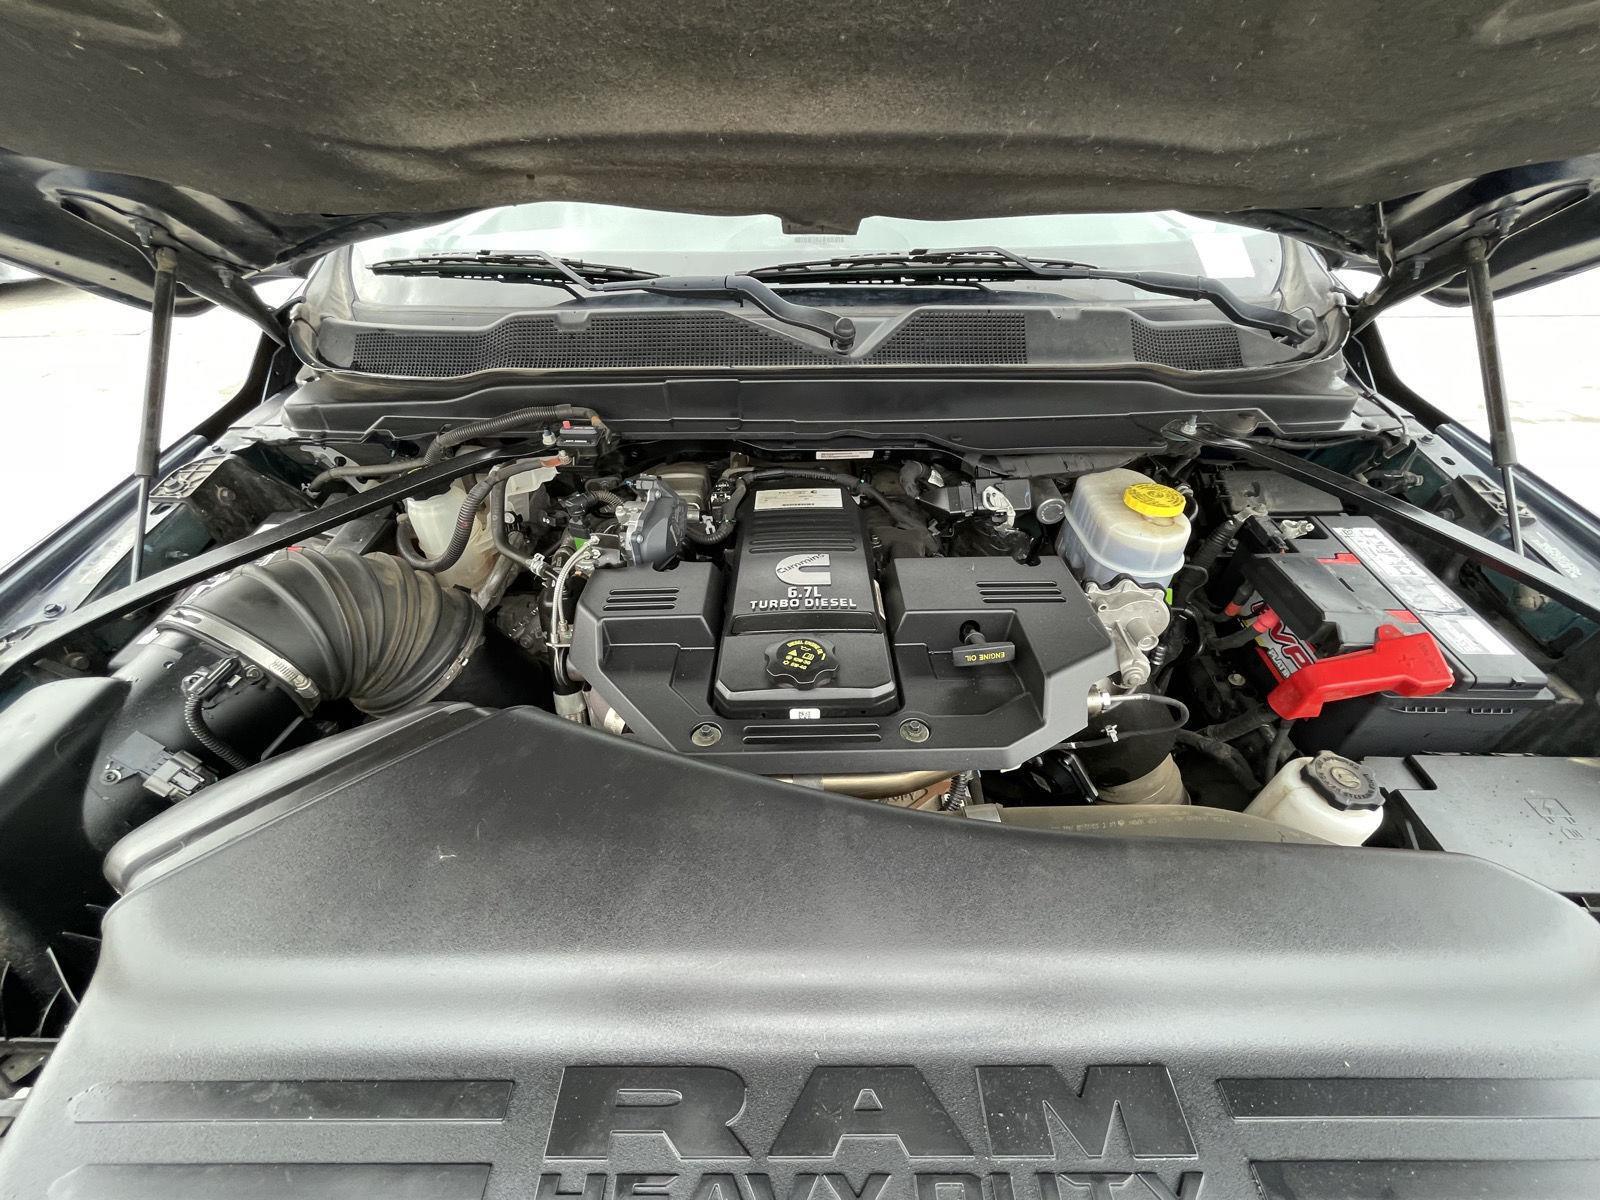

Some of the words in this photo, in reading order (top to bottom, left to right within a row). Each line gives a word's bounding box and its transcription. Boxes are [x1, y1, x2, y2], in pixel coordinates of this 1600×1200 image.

[776, 553, 825, 574] Cummins
[787, 586, 822, 598] 6.7L
[750, 598, 800, 610] TURBO
[804, 598, 857, 609] DIESEL
[964, 654, 977, 662] OIL
[979, 651, 1006, 661] ENGINE
[544, 1064, 1199, 1159] RAM
